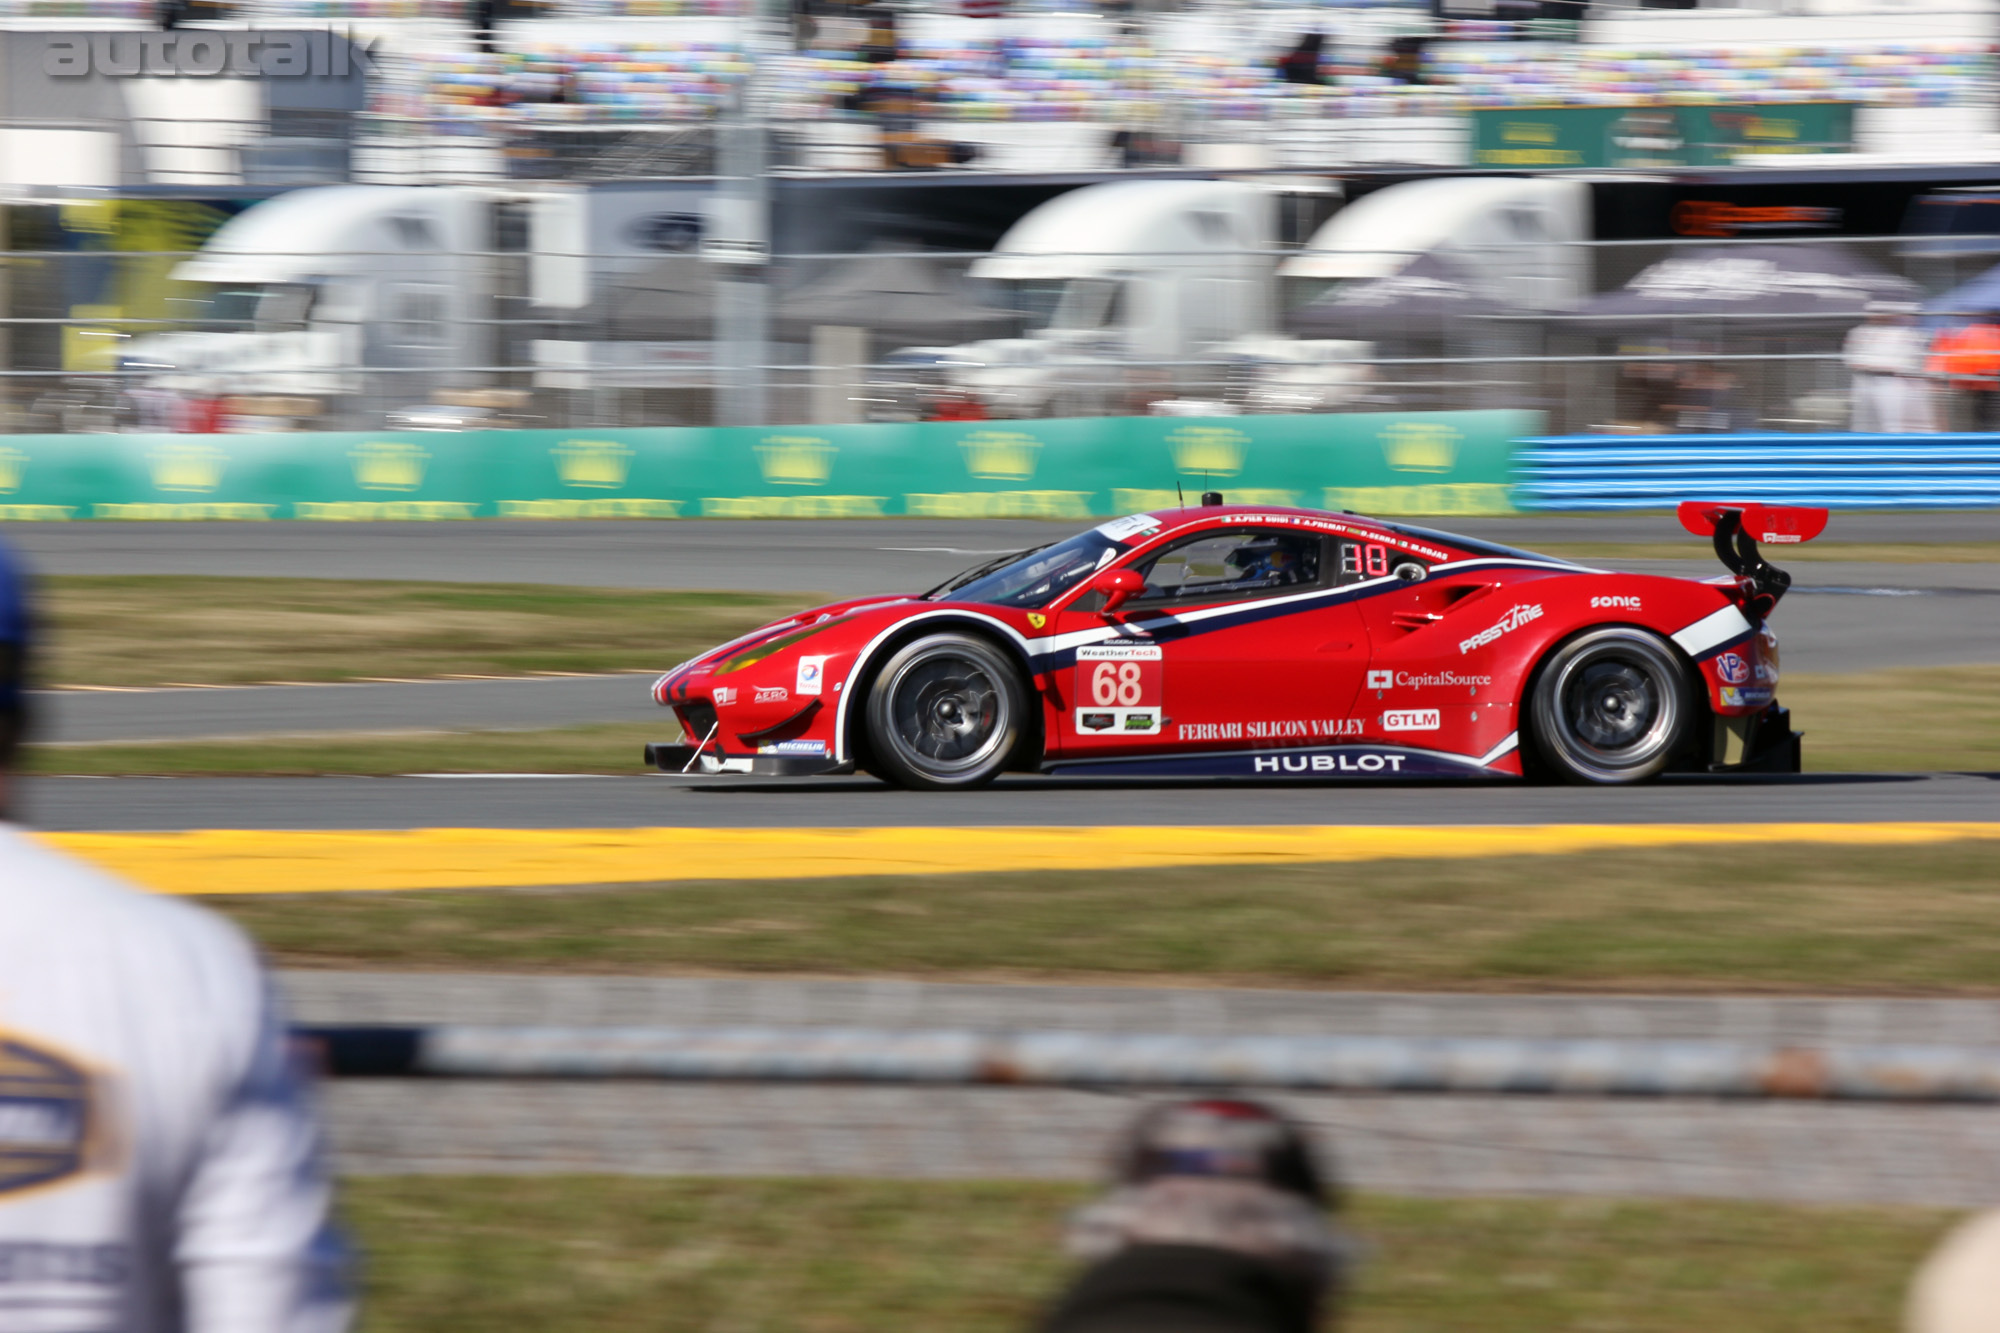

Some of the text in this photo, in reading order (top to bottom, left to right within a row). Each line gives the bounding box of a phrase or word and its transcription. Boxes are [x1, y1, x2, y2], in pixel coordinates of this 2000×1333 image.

[1081, 649, 1157, 657] WeatherTech
[1092, 661, 1143, 707] 68
[1395, 671, 1492, 690] CapitalSource
[754, 690, 789, 701] AERO
[1387, 713, 1437, 727] GTLM
[1178, 718, 1367, 740] FERRARI SILICON VALLEY
[777, 742, 825, 751] MICHELIN
[1254, 754, 1406, 772] HUBLOT
